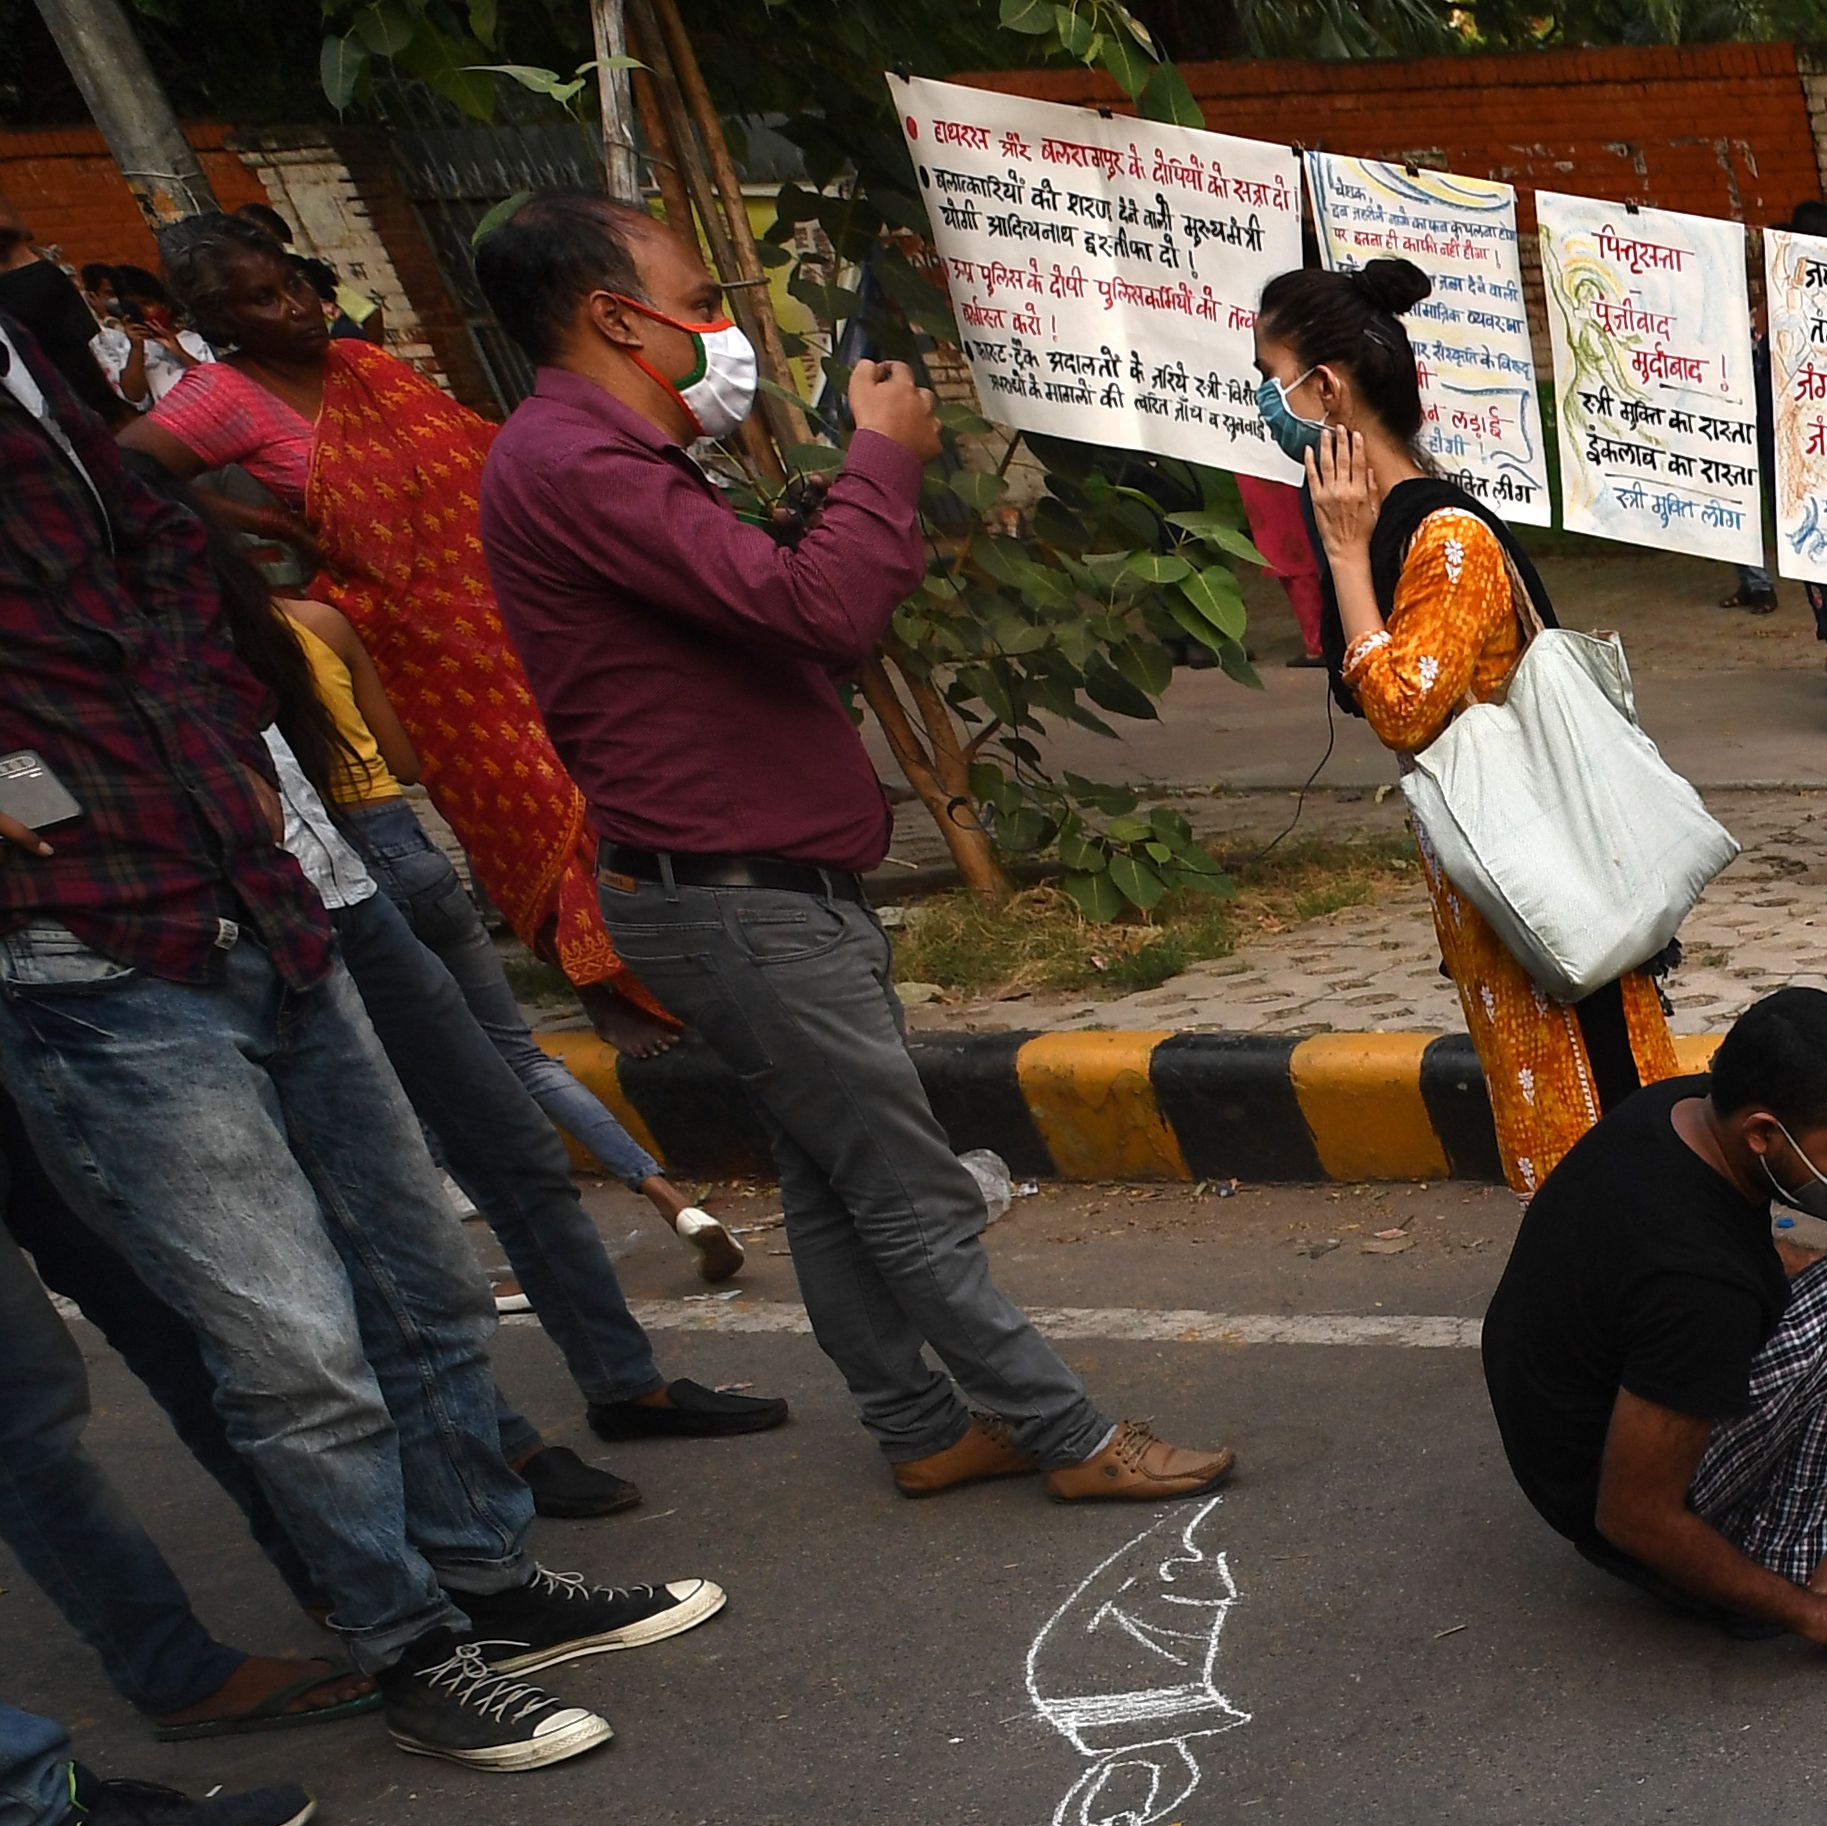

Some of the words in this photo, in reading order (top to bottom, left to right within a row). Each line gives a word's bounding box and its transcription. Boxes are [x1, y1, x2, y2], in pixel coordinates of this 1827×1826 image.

[933, 120, 990, 149] हाथरस
[1041, 138, 1125, 182] बलरामपुर
[932, 168, 1025, 204] बलात्कारियों
[1067, 191, 1112, 221] शरण
[939, 199, 982, 230] योगी
[1332, 227, 1348, 242] पर
[977, 261, 1026, 297] पुलिस
[1027, 258, 1043, 294] के
[1196, 286, 1221, 321] को
[1490, 280, 1518, 301] वाली
[1130, 351, 1145, 383] के
[1579, 387, 1615, 419] स्त्री
[1668, 408, 1695, 433] का
[1698, 413, 1756, 445] रास्ता
[1667, 450, 1698, 476] का
[1700, 456, 1758, 488] रास्ता
[1493, 474, 1536, 503] लीग
[1614, 485, 1649, 513] स्त्री
[1702, 499, 1746, 531] लीग
